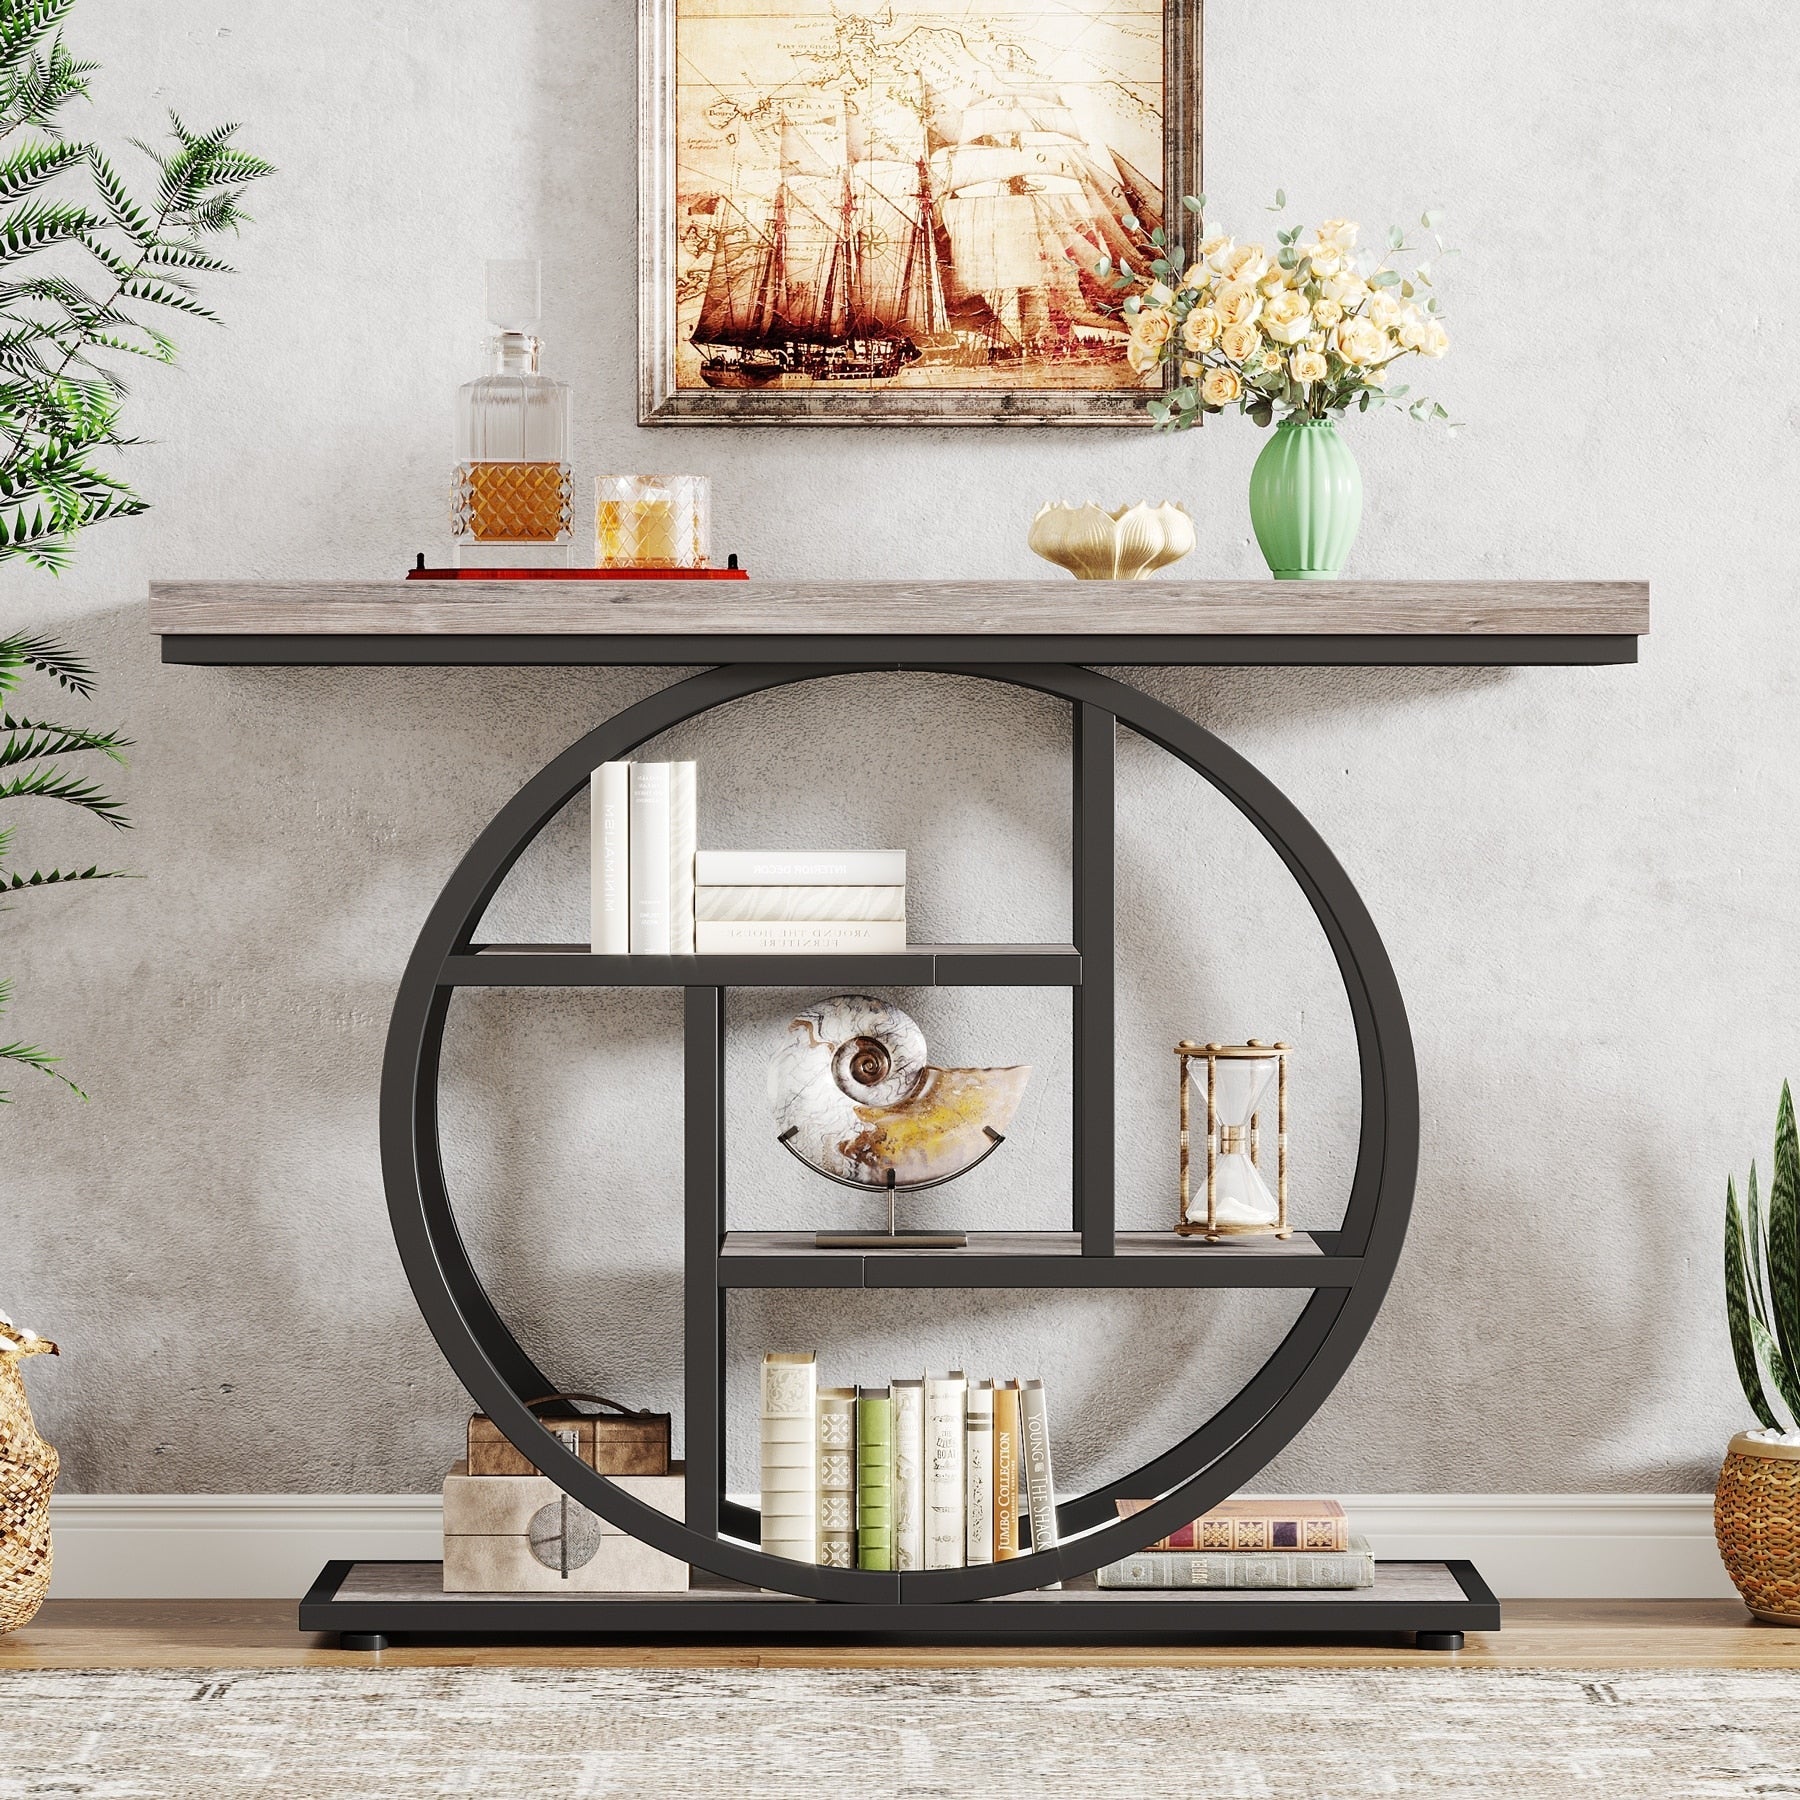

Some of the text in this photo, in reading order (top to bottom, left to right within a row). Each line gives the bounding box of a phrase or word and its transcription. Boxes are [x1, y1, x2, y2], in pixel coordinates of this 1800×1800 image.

[998, 1431, 1013, 1552] JUMBO COLLECTION
[1028, 1412, 1053, 1551] YOUNG THE SHACK
